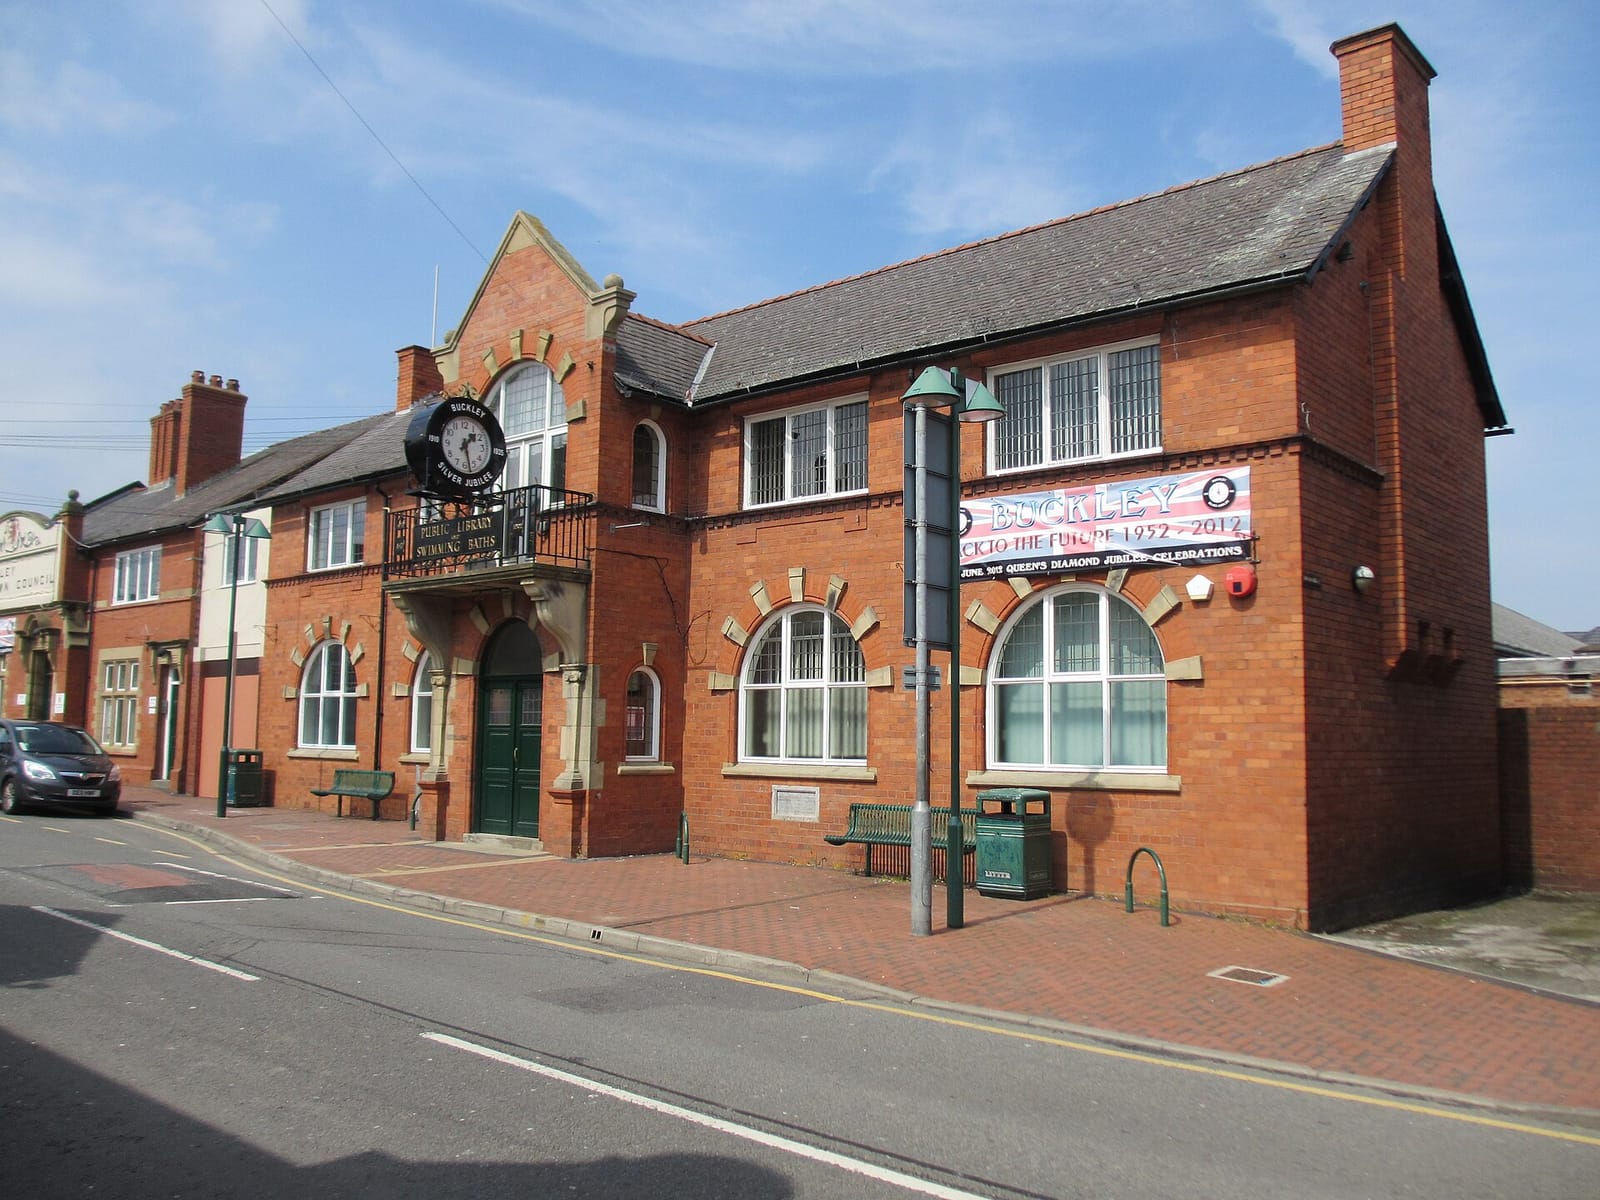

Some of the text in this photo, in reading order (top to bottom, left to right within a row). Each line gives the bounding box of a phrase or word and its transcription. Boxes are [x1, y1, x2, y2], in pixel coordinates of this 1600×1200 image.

[450, 402, 486, 418] BUCKLEY
[437, 461, 494, 487] SILVER JUBILEE
[991, 482, 1179, 532] BUCKLEY
[421, 516, 493, 538] PUBLIC LIBRARY
[987, 538, 1008, 554] TO
[1013, 535, 1044, 551] THE
[1049, 528, 1115, 547] FUTURE
[1123, 523, 1169, 542] 1952
[1191, 516, 1242, 536] 2012
[416, 535, 495, 558] SWIMMING BATHS
[961, 567, 985, 578] JUNE
[1005, 560, 1048, 574] QUEEN'S
[1051, 556, 1100, 570] DIAMOND
[1103, 551, 1149, 565] JUBILEE
[1151, 545, 1243, 562] CELEBRATIONS
[16, 574, 55, 591] COUNCIL
